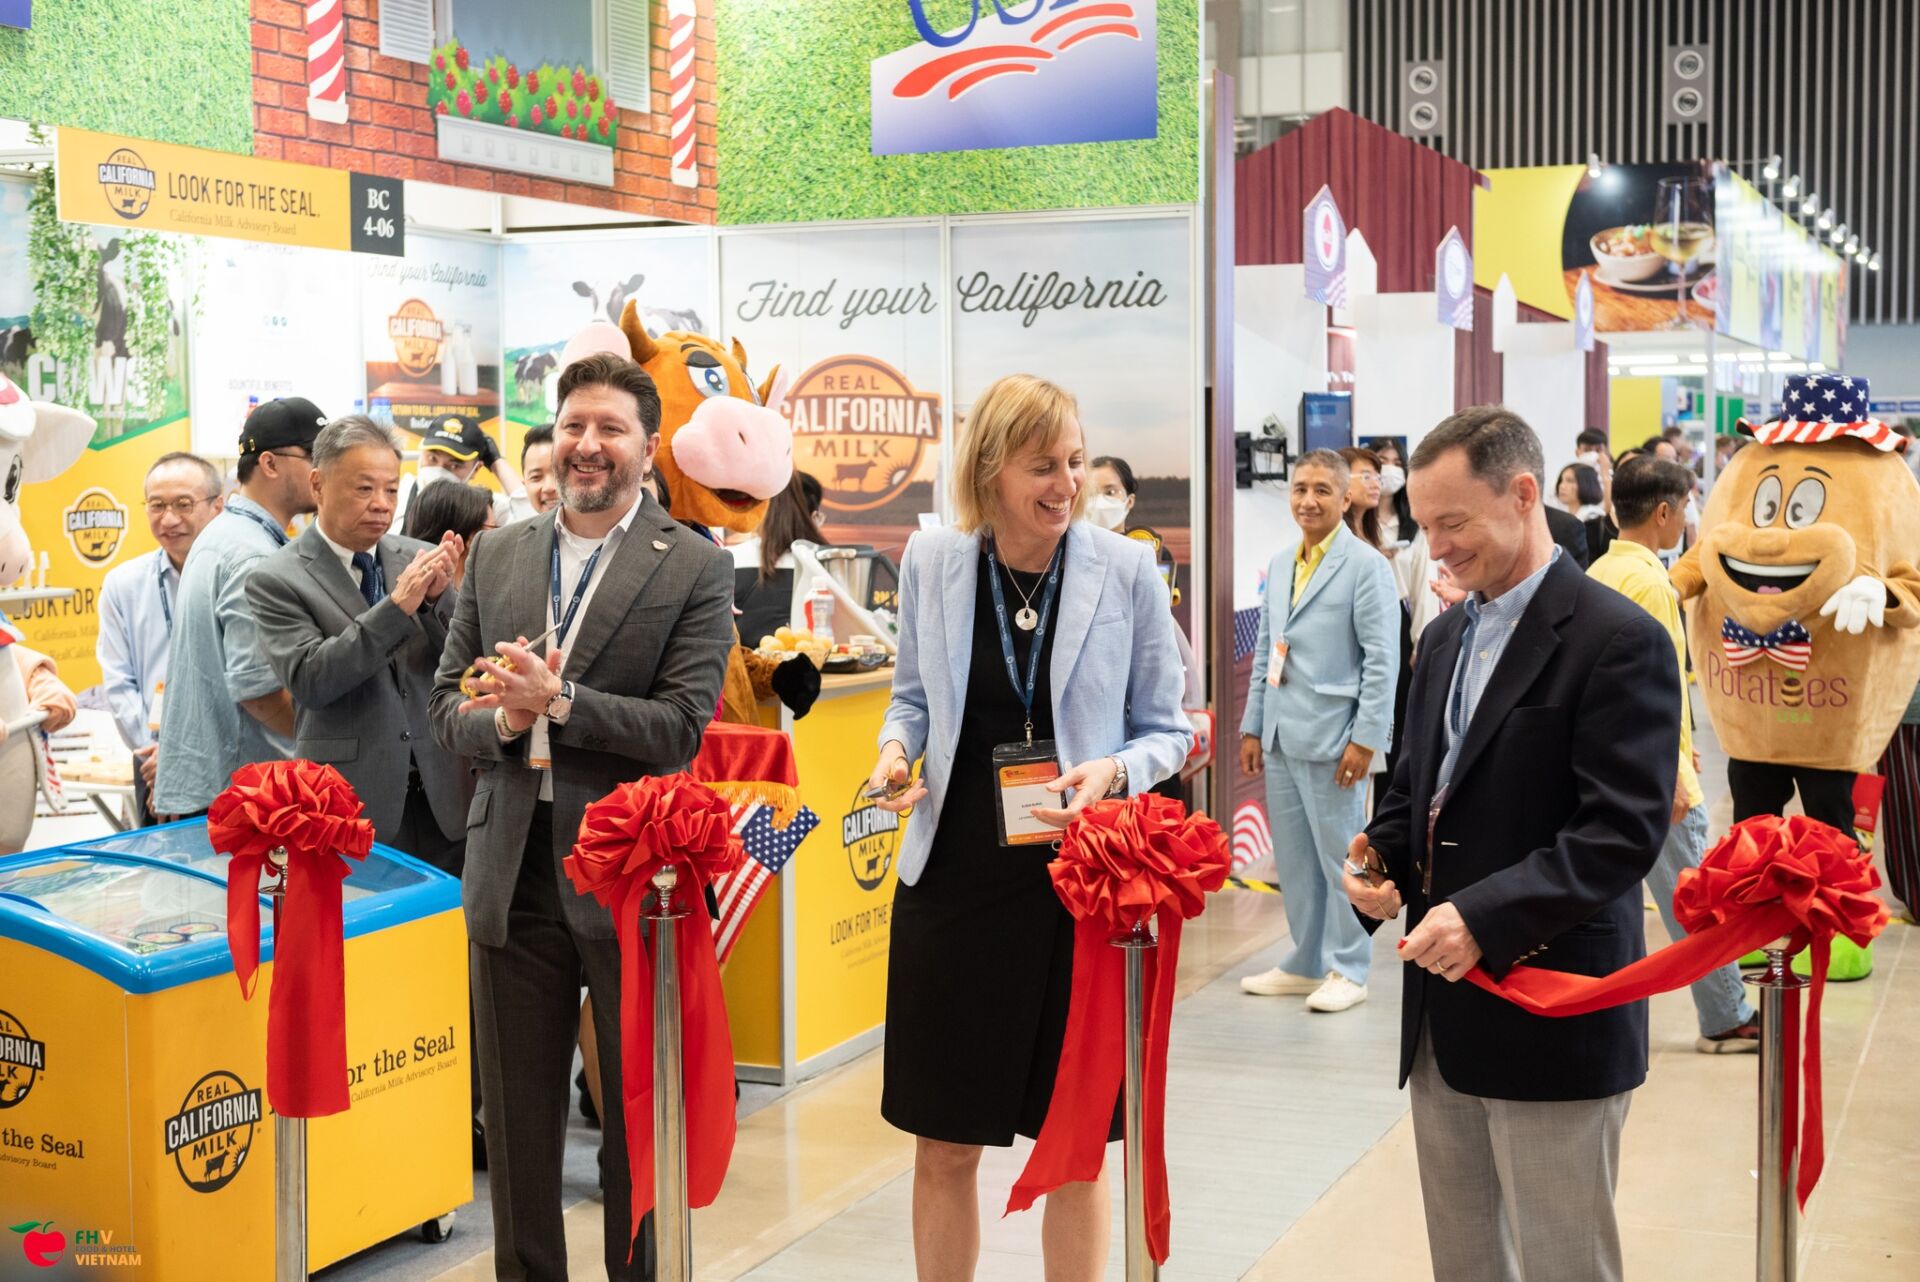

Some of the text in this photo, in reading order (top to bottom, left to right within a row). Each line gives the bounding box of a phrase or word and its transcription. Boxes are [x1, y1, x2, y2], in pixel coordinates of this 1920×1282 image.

[99, 164, 155, 189] CALIFORNIA
[114, 186, 141, 198] MILK
[168, 171, 320, 217] LOOK FOR THE SEAL.
[366, 187, 391, 212] BC
[169, 208, 212, 226] California
[214, 214, 234, 228] Milk
[272, 222, 297, 235] Board
[362, 215, 395, 239] 4-06
[431, 262, 488, 292] California
[737, 270, 1168, 330] Find your California
[823, 375, 881, 390] REAL
[812, 439, 891, 457] MILK
[68, 511, 123, 531] CALIFORNIA
[83, 529, 110, 541] MILK
[63, 588, 95, 615] FOR
[1776, 709, 1813, 723] USA
[843, 806, 898, 847] CALIFORNIA
[858, 838, 885, 857] MILK
[831, 904, 887, 945] LOOK FOR THE
[0, 1020, 12, 1032] AL
[348, 1026, 456, 1087] or the Seal
[197, 1081, 230, 1102] REAL
[351, 1057, 457, 1103] California Milk Advisory Board
[168, 1092, 259, 1149] CALIFORNIA
[2, 1127, 84, 1159] the Seal
[192, 1130, 237, 1160] MILK
[33, 1157, 57, 1169] Board
